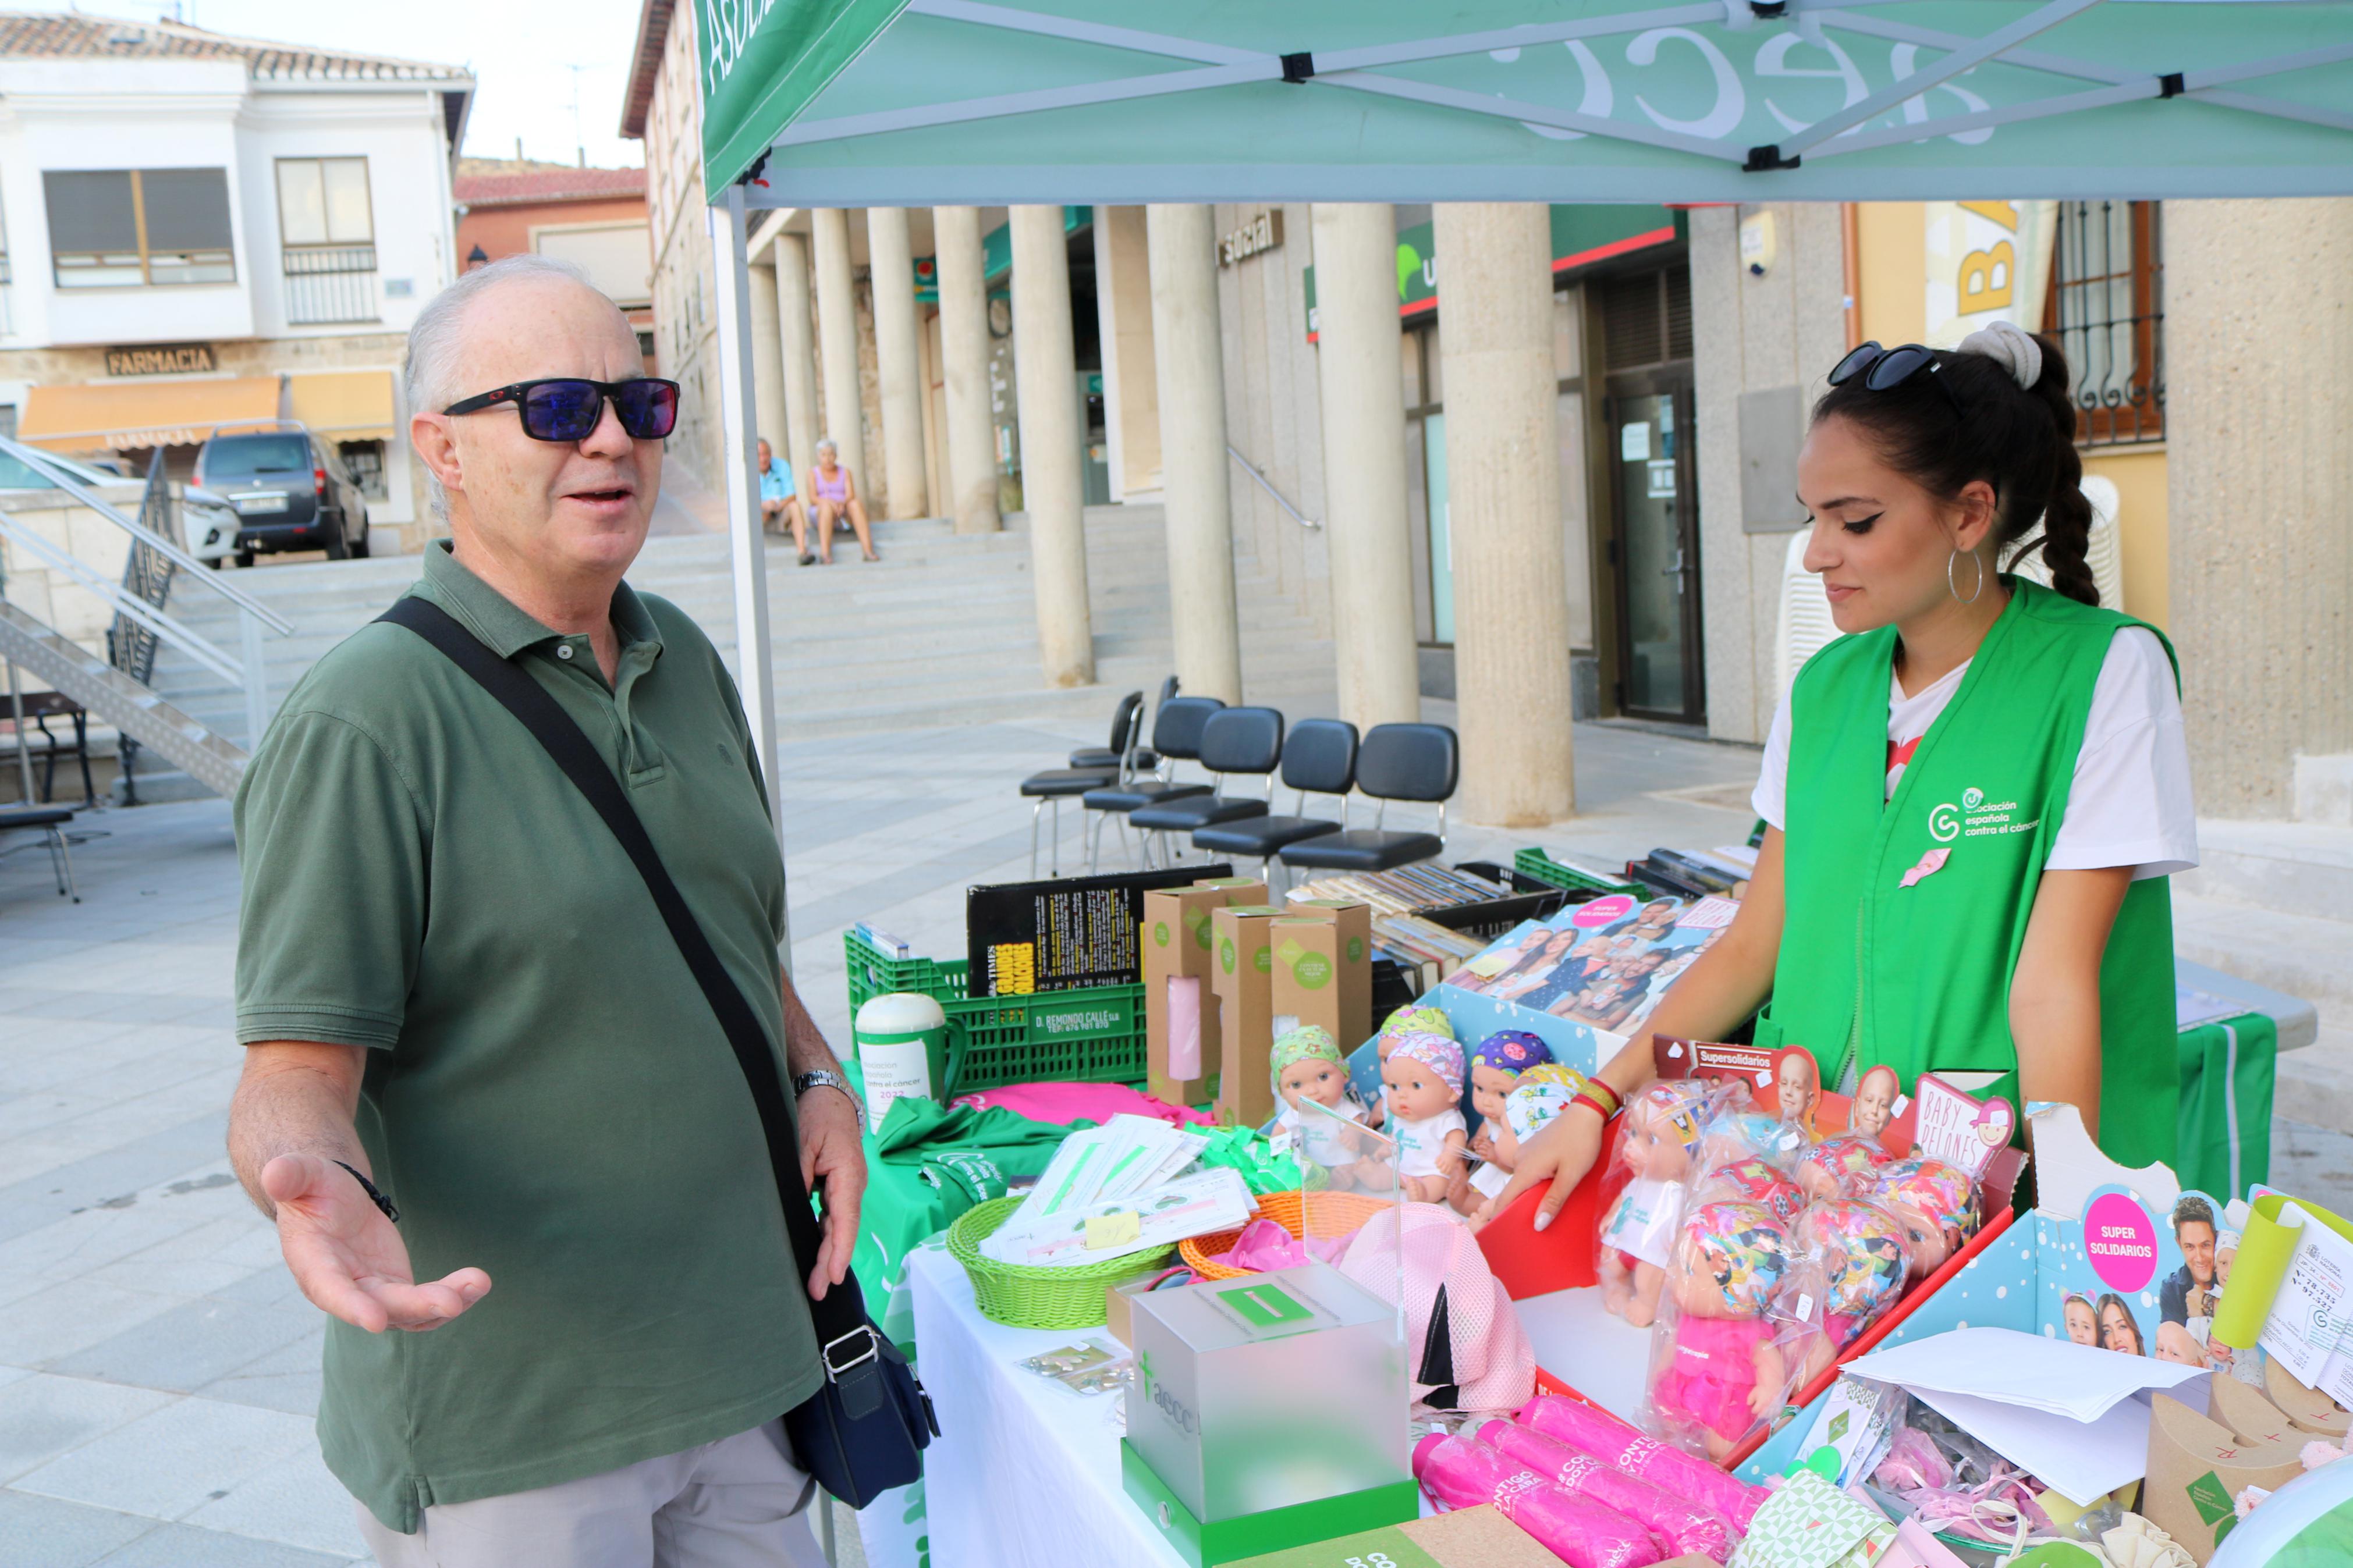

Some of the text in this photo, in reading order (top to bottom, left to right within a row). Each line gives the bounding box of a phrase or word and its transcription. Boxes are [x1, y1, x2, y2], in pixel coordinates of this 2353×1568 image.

[1225, 211, 1274, 263] social
[108, 349, 212, 375] FARMACIA
[1965, 801, 2017, 813] ociación
[1965, 813, 2010, 826] española
[1965, 826, 1997, 837] contra
[1999, 824, 2008, 833] el
[988, 945, 996, 980] TIMES
[995, 943, 1014, 994] GRANDES
[1013, 941, 1034, 995] ORACIONES
[1046, 1012, 1083, 1027] REMONDO
[1085, 1011, 1108, 1023] CALLE
[1699, 1050, 1771, 1068] Supersolidarios
[893, 1078, 921, 1087] cáncer
[1923, 1091, 1962, 1131] BABY
[1922, 1124, 1978, 1166] PELONES
[2100, 1225, 2136, 1239] SUPER
[2090, 1242, 2152, 1258] SOLIDARIOS
[2319, 1260, 2343, 1281] NACIONAL
[2320, 1256, 2341, 1274] LOTERÍA
[1154, 1382, 1193, 1433] aecc
[1565, 1463, 1587, 1488] DOY
[1493, 1471, 1534, 1513] ONTIGO
[1503, 1495, 1511, 1512] LA
[1509, 1477, 1542, 1494] CARA
